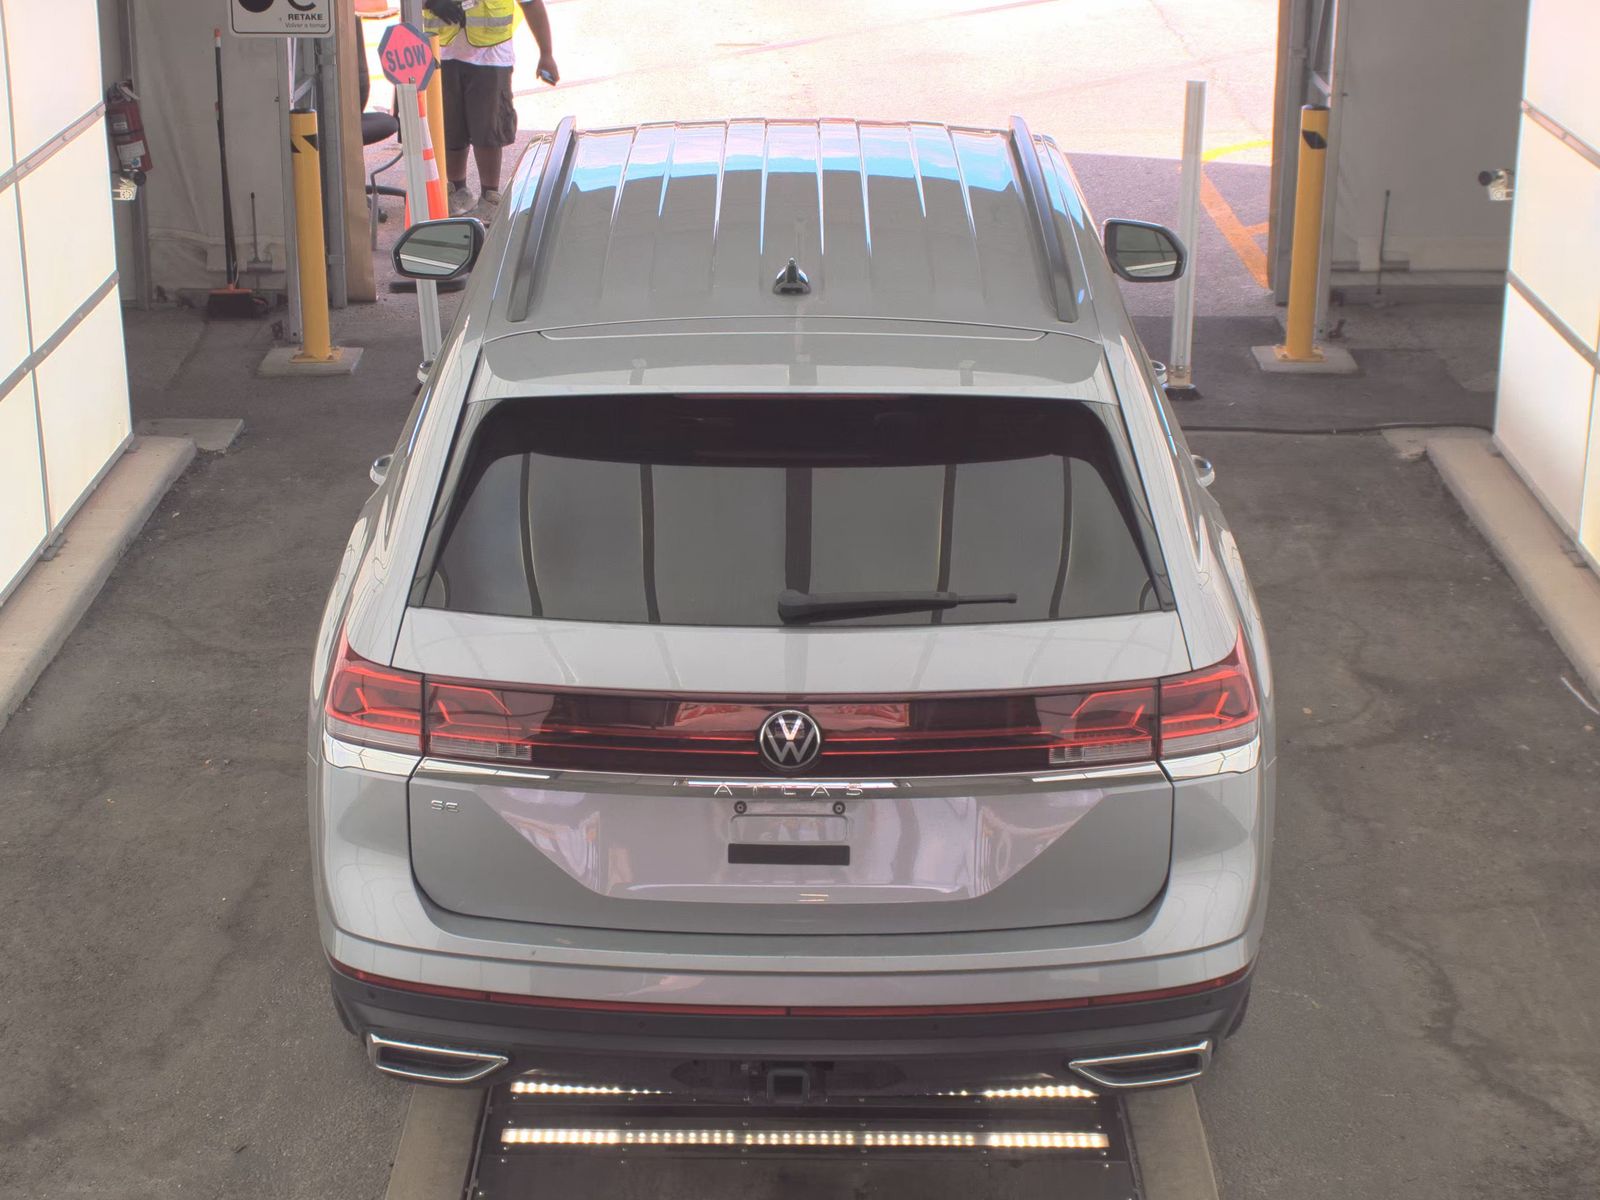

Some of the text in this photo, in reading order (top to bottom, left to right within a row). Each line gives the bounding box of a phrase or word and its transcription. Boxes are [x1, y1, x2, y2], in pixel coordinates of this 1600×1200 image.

[288, 13, 323, 21] RETAKE
[385, 44, 427, 72] SLOW
[714, 783, 864, 797] ATLAS
[431, 800, 459, 812] SE
